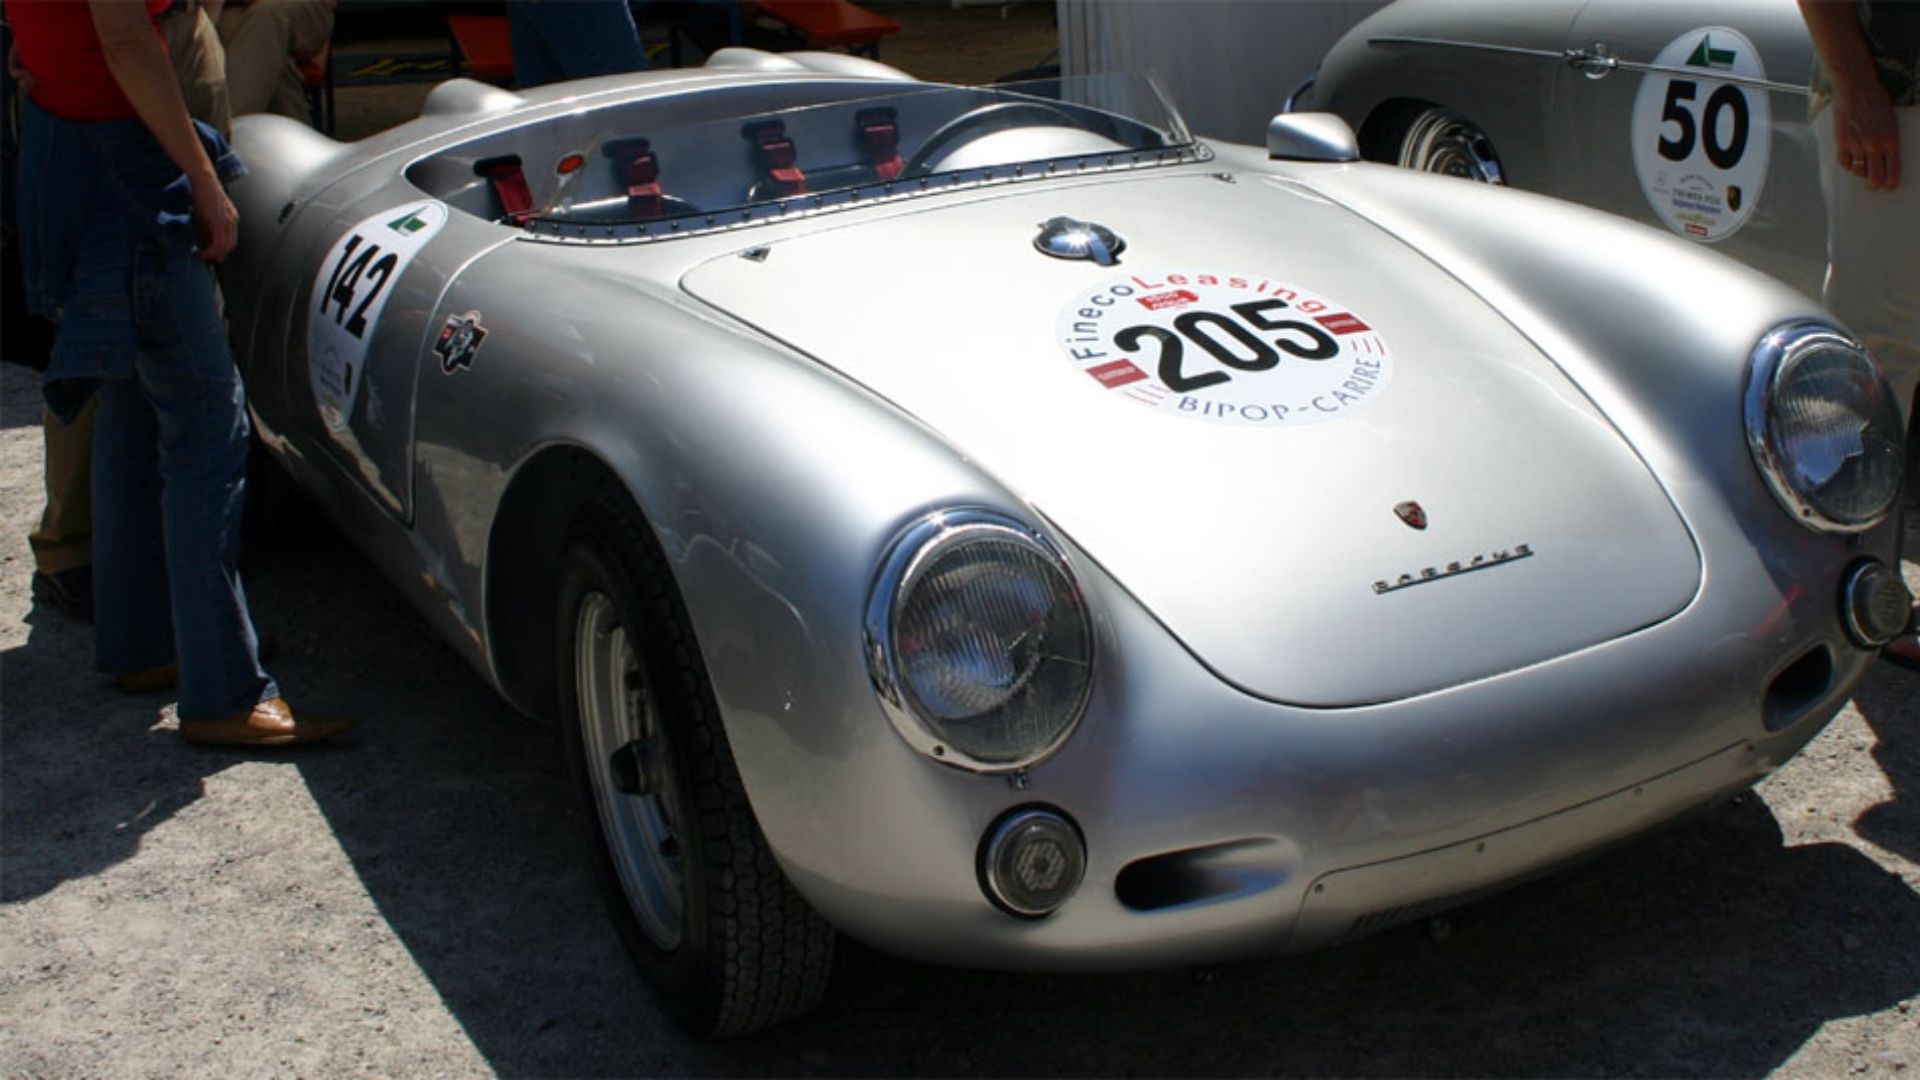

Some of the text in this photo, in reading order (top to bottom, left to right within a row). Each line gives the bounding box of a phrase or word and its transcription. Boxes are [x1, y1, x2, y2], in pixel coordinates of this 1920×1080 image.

[1658, 80, 1749, 170] 50
[320, 234, 398, 339] 142
[1113, 298, 1340, 393] 205
